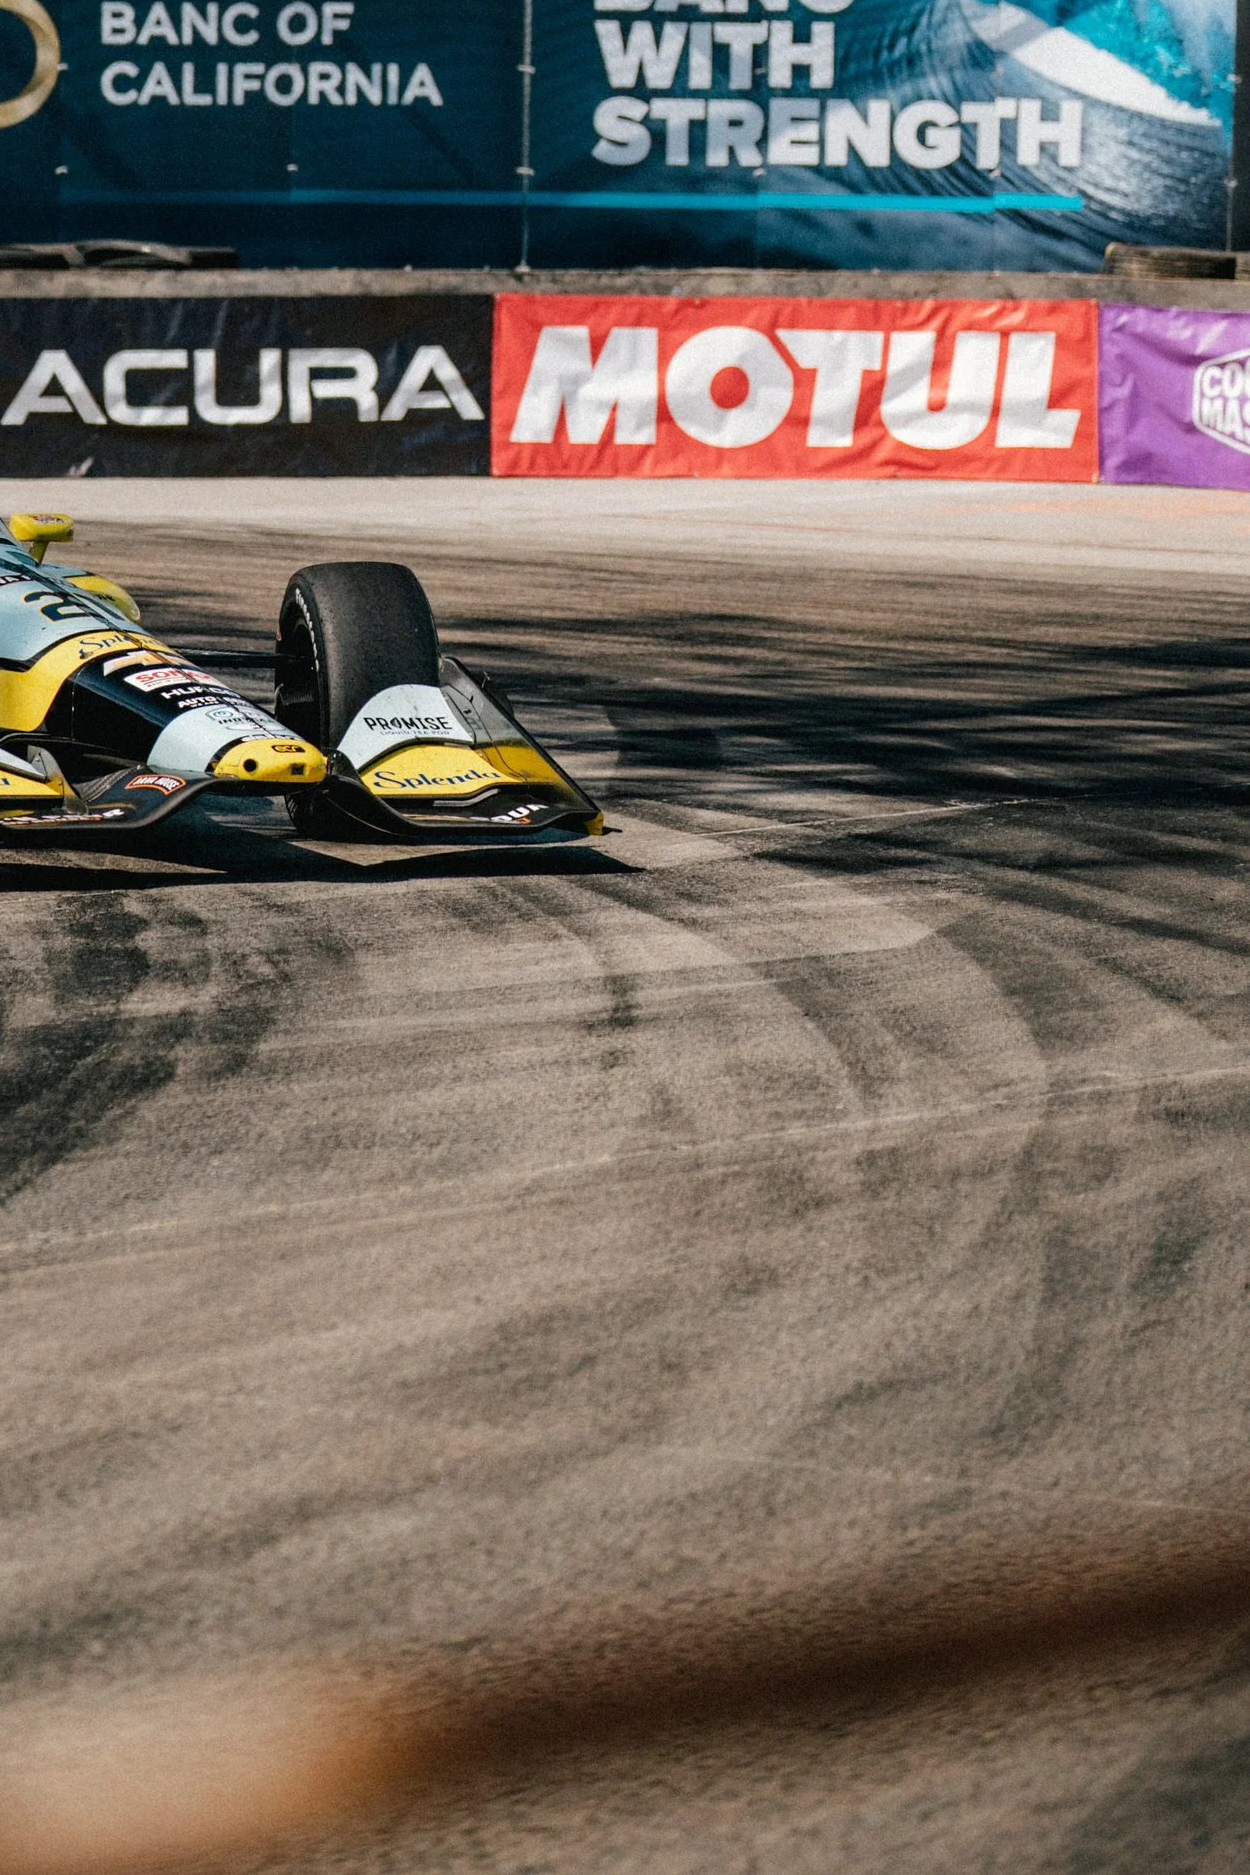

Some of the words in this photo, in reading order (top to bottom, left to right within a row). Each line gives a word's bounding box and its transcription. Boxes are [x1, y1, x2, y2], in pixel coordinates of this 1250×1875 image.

[100, 1, 260, 46] BANC
[276, 1, 355, 46] OF
[594, 20, 835, 90] WITH
[100, 61, 444, 107] CALIFORNIA
[591, 96, 1083, 169] STRENGTH
[0, 345, 485, 426] ACURA
[509, 325, 1081, 450] MOTUL
[1201, 362, 1250, 400] CO
[1201, 397, 1250, 443] MA
[363, 716, 453, 731] PROMISE
[374, 770, 501, 790] Splenda
